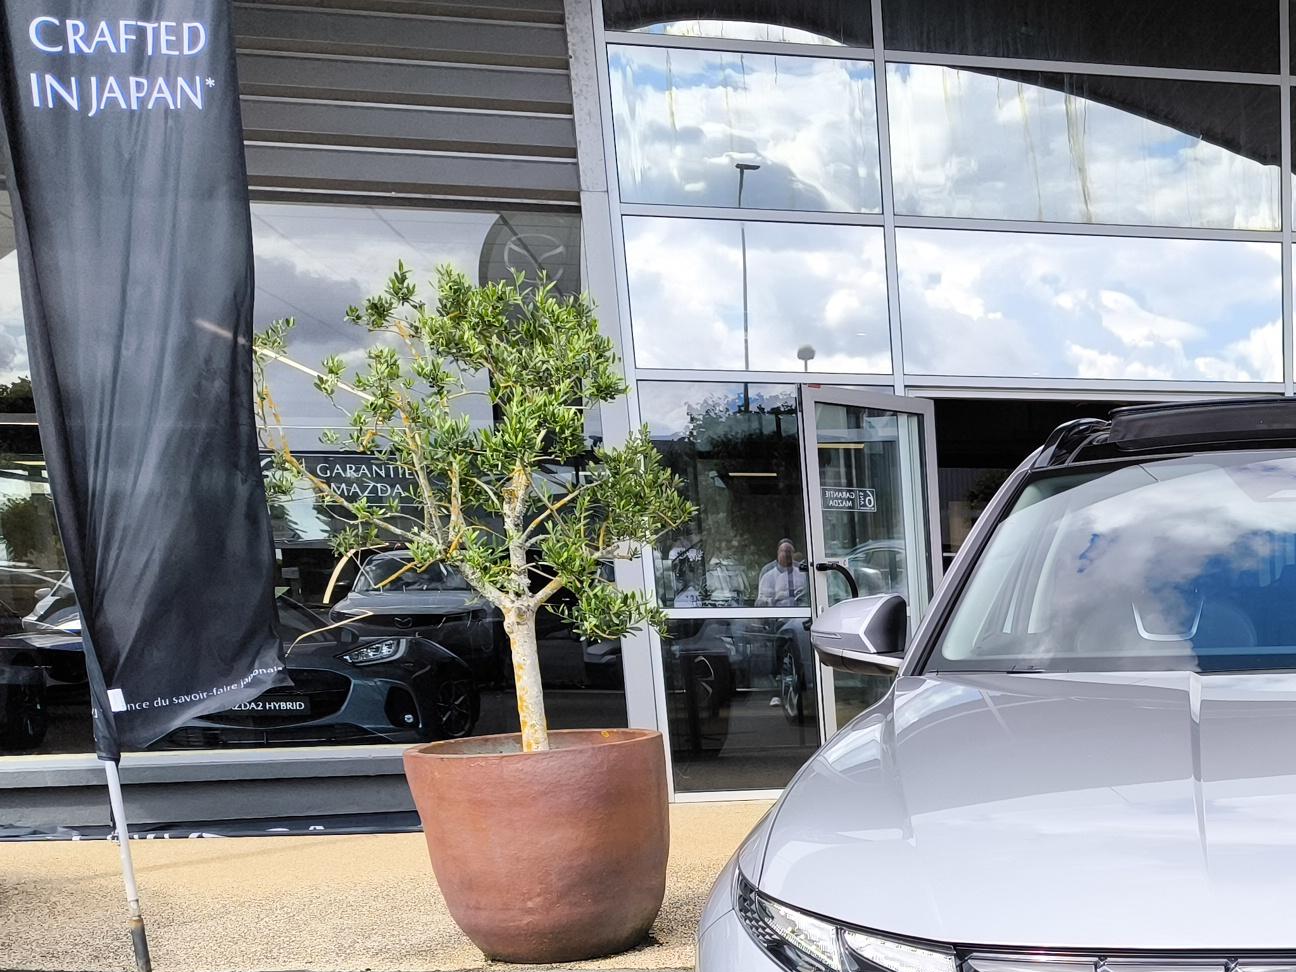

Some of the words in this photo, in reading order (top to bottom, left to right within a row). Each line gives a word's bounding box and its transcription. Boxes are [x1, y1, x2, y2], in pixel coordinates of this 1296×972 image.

[28, 16, 206, 56] CRAFTED
[30, 72, 79, 111] IN
[316, 463, 414, 479] GARANTIE
[330, 483, 405, 497] MAZDA
[153, 696, 169, 708] du
[172, 683, 238, 704] savoir-faire
[231, 701, 263, 711] ZDA2
[266, 701, 305, 711] HYBRID
